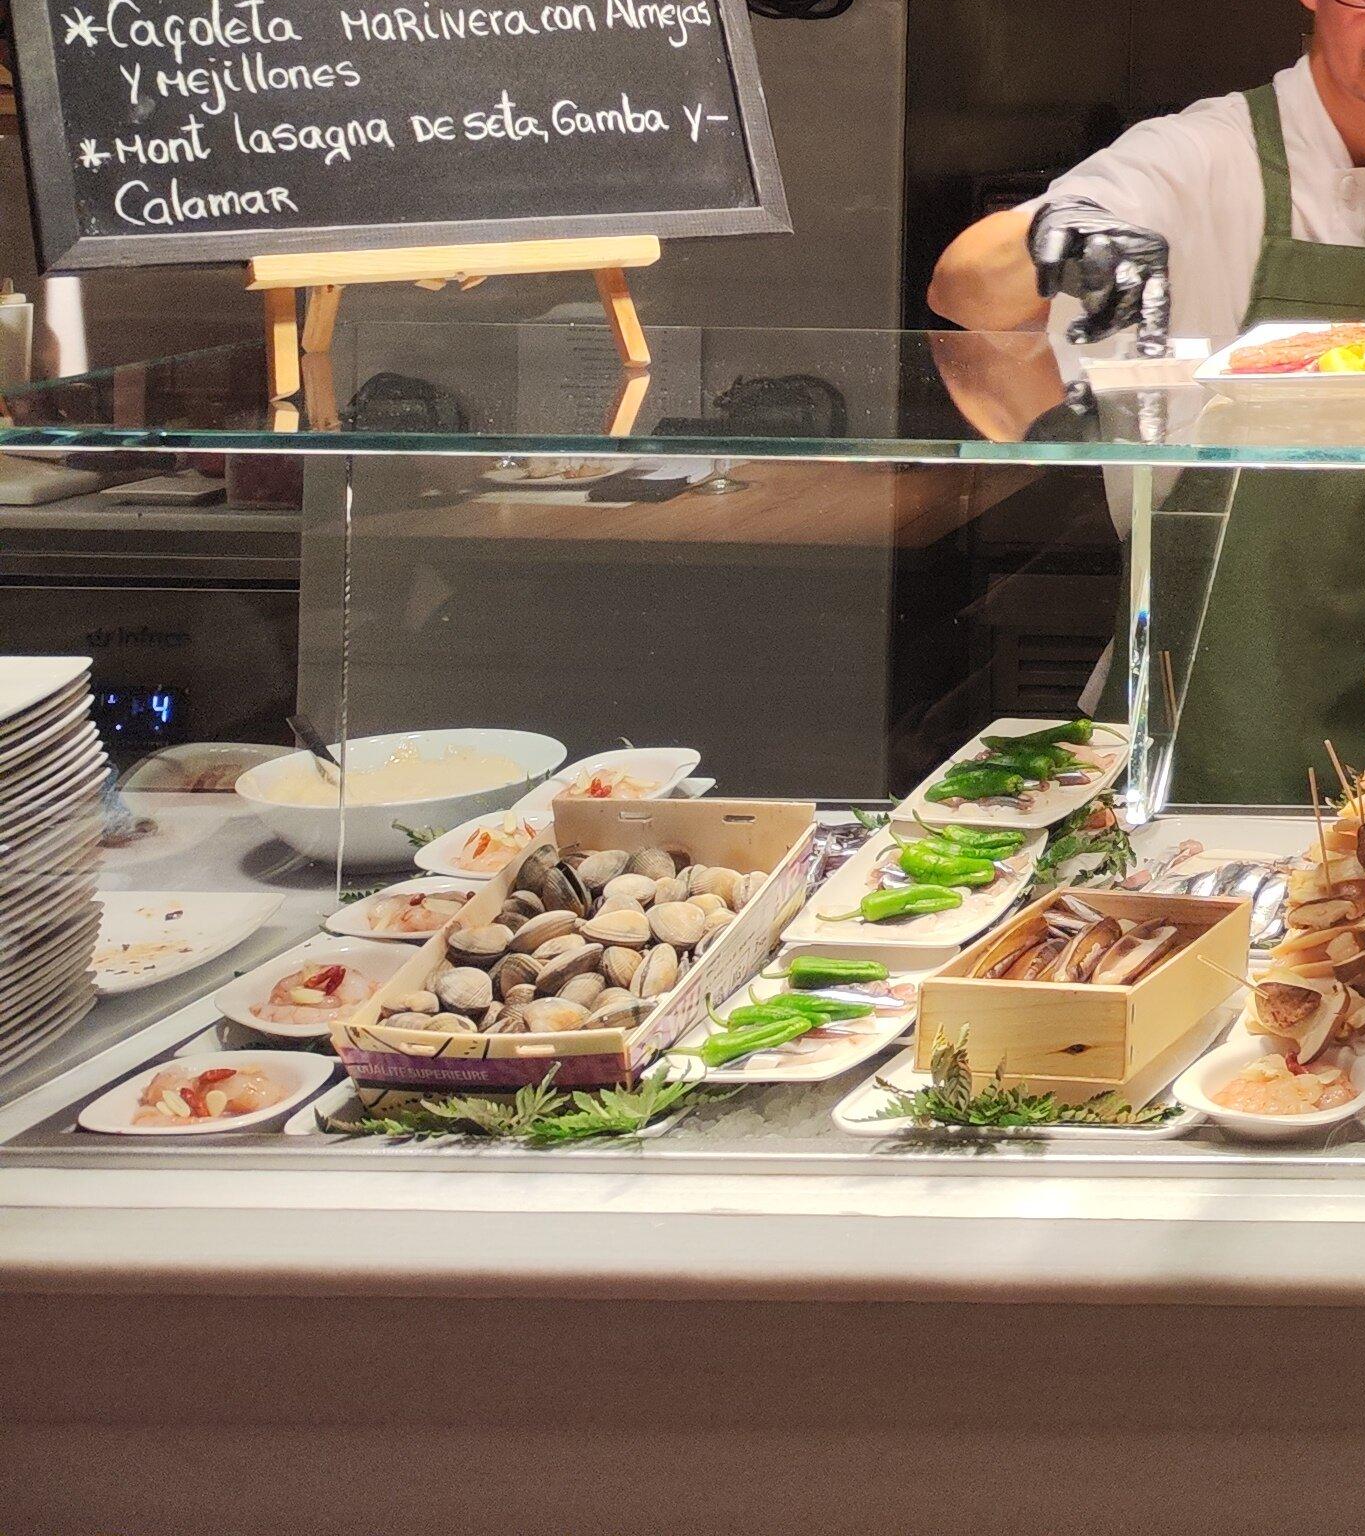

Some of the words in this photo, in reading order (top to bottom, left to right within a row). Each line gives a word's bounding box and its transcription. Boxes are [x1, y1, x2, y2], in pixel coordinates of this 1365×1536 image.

[541, 4, 597, 32] con
[156, 51, 362, 116] Mejillones
[115, 113, 211, 164] Mont
[233, 111, 396, 166] lasagna
[551, 91, 670, 137] Gamba
